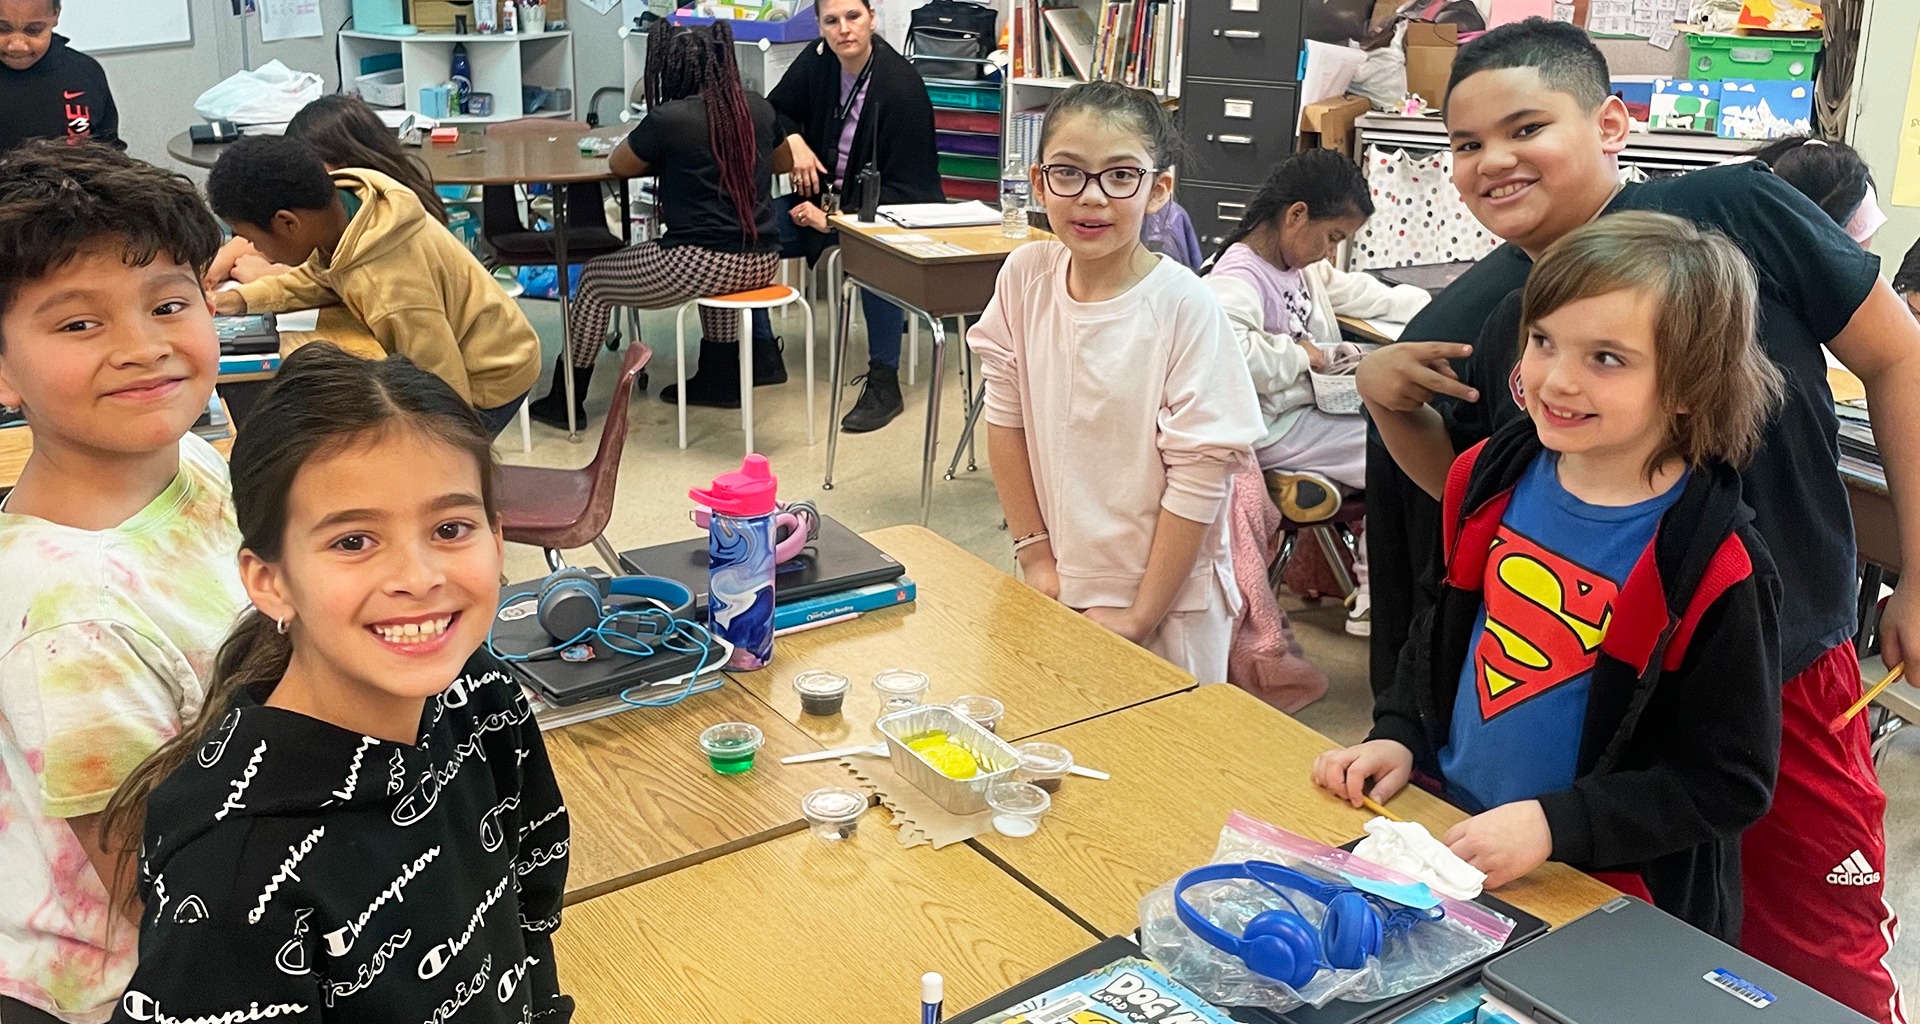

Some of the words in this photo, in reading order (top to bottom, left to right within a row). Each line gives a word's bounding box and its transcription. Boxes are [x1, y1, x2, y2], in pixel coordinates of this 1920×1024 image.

[322, 845, 441, 957] Champion
[1826, 871, 1880, 886] adidas
[418, 876, 508, 980] Champion
[1091, 989, 1128, 1011] LORD
[1105, 973, 1181, 1019] DOG
